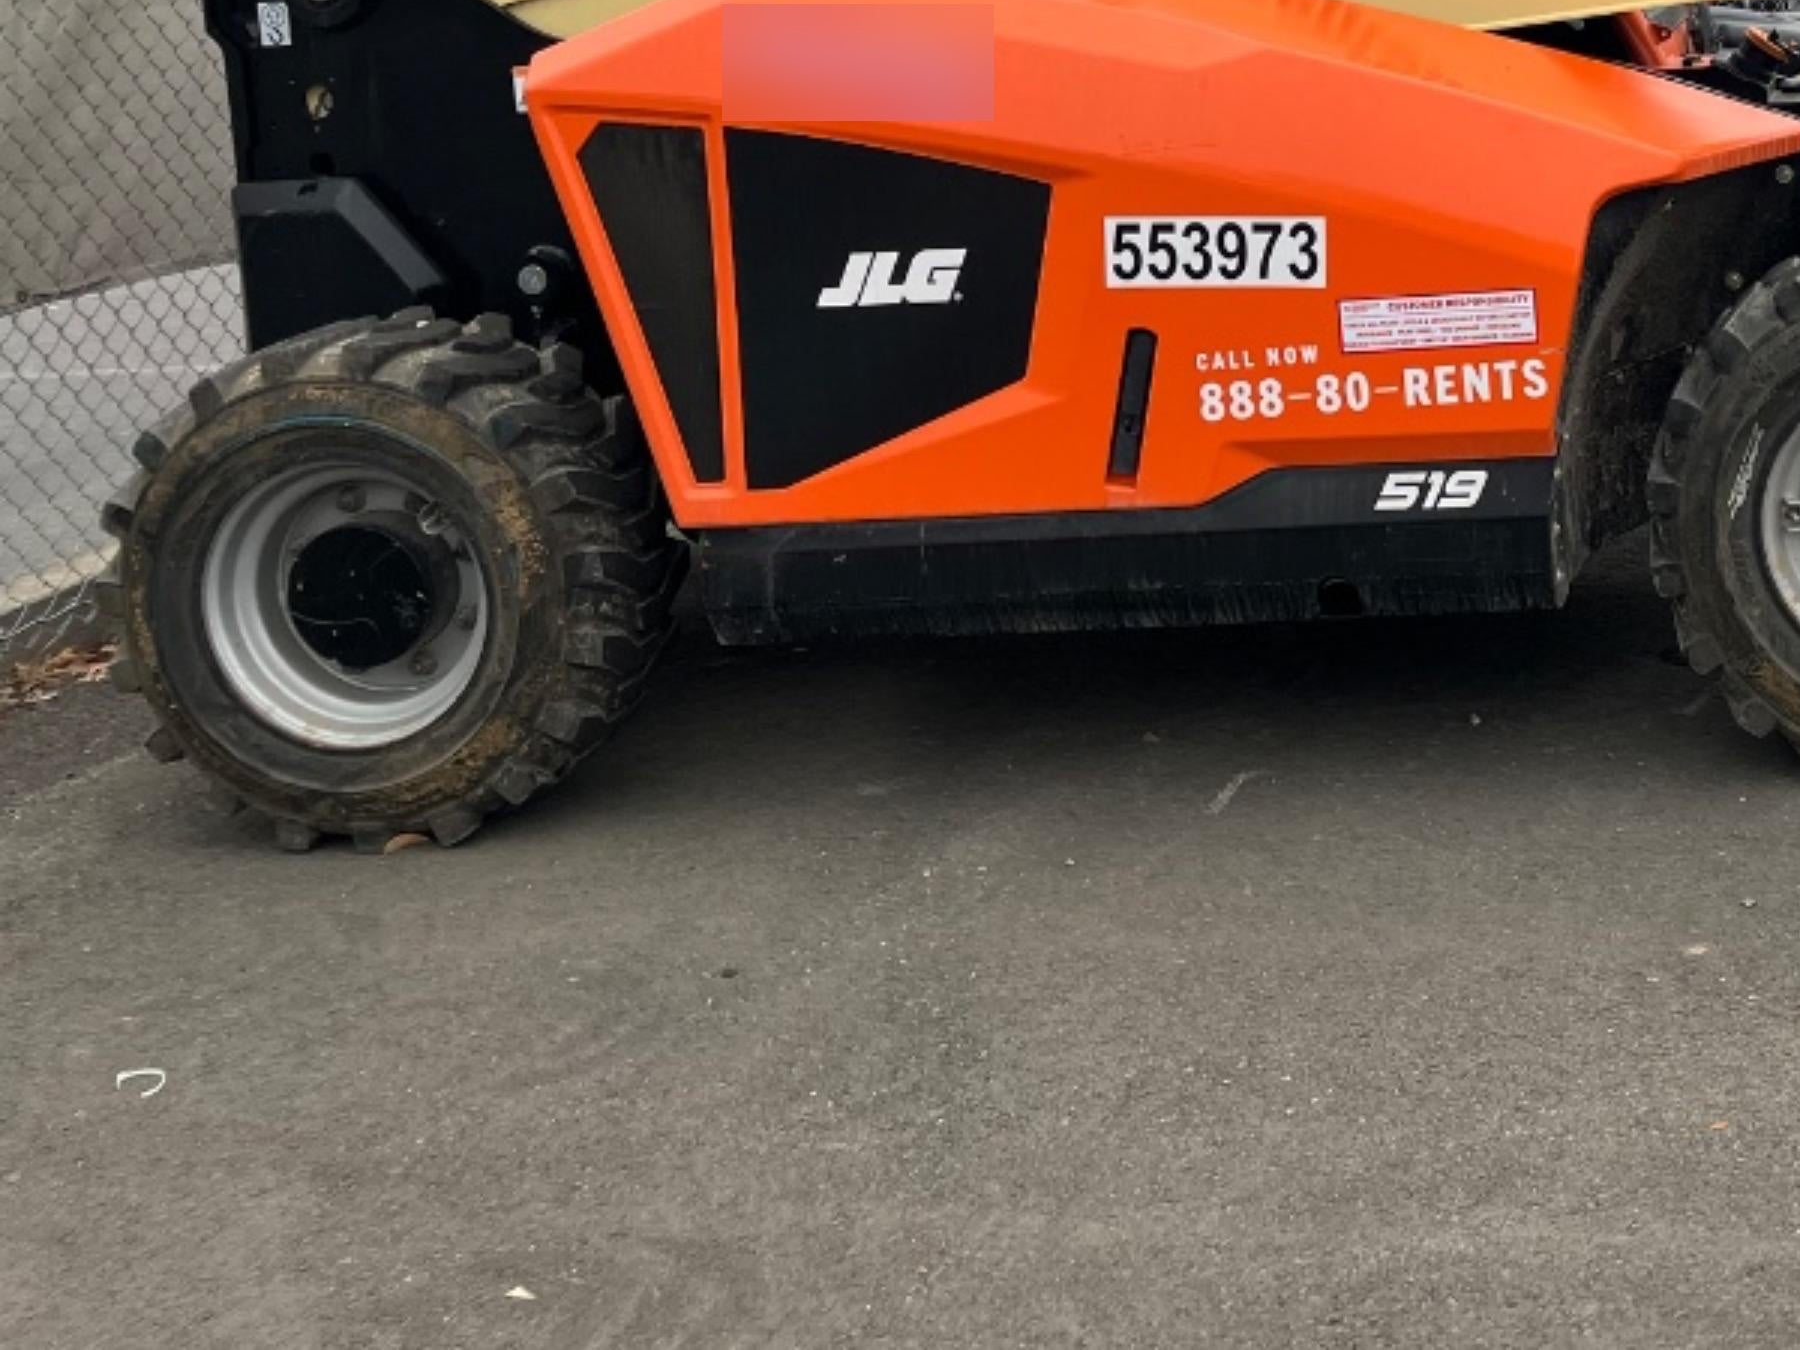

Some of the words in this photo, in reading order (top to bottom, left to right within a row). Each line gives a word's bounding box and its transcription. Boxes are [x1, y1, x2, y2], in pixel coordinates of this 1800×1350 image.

[817, 248, 967, 308] JLG
[1112, 221, 1319, 281] 553973
[1196, 352, 1254, 371] CALL
[1266, 345, 1318, 367] NOW
[1199, 358, 1549, 422] 888-80-RENTS
[1374, 469, 1488, 511] 519
